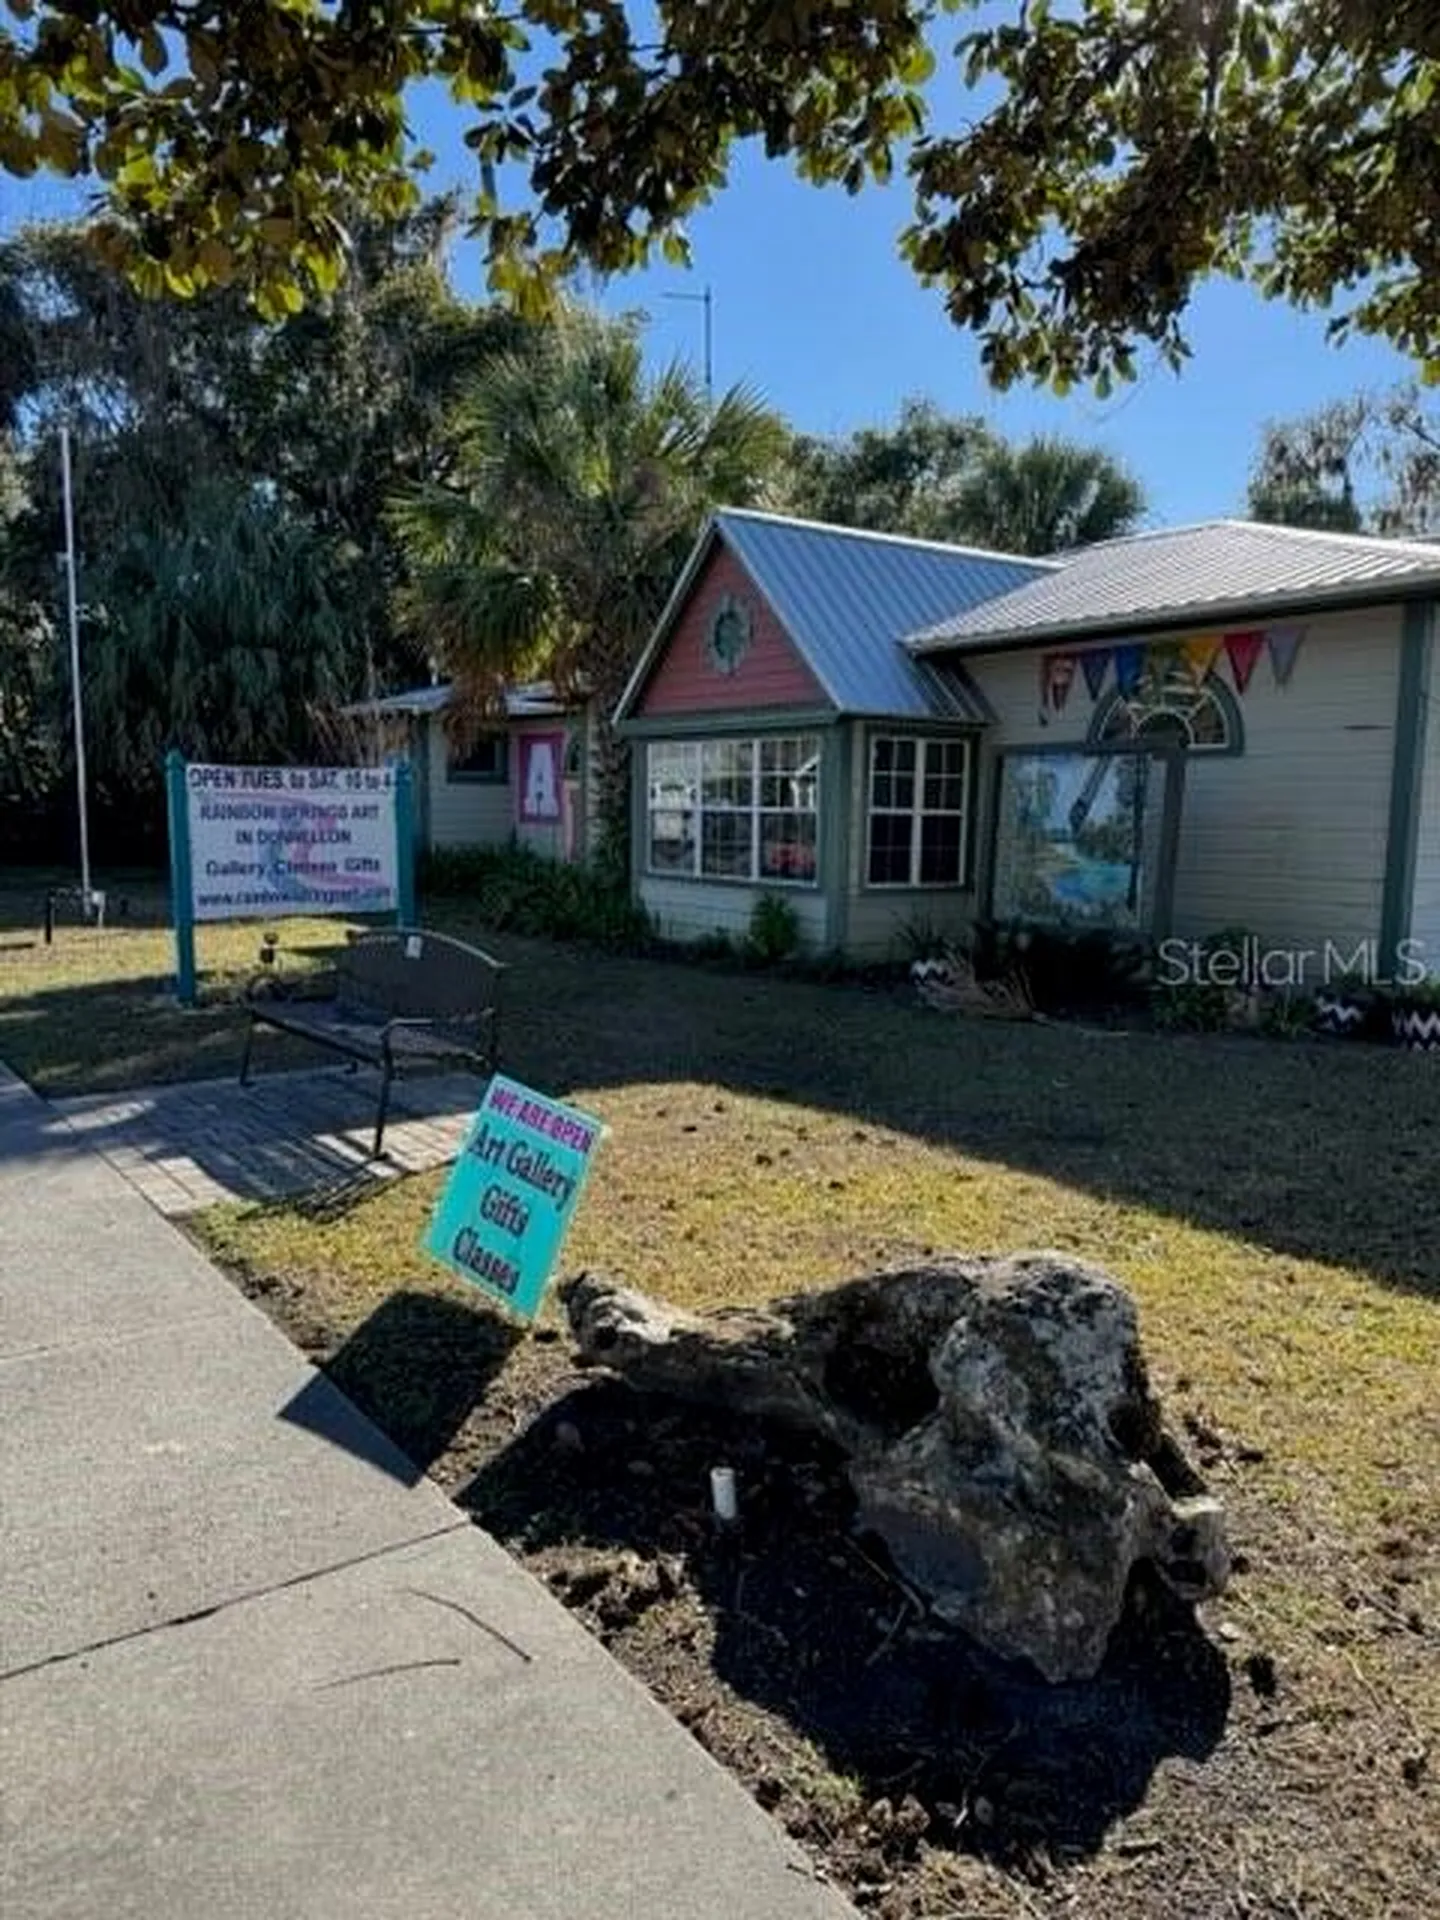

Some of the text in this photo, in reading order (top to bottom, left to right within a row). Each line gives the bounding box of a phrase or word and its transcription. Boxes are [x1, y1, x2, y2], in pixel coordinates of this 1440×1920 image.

[189, 767, 235, 789] OPEN
[200, 804, 276, 820] RAINBOW
[351, 805, 380, 819] ART
[235, 829, 253, 845] IN
[489, 1086, 596, 1154] WE ARE OPEN
[467, 1123, 577, 1213] Art Gallery
[479, 1183, 530, 1238] Gifts
[453, 1226, 521, 1296] Classes
